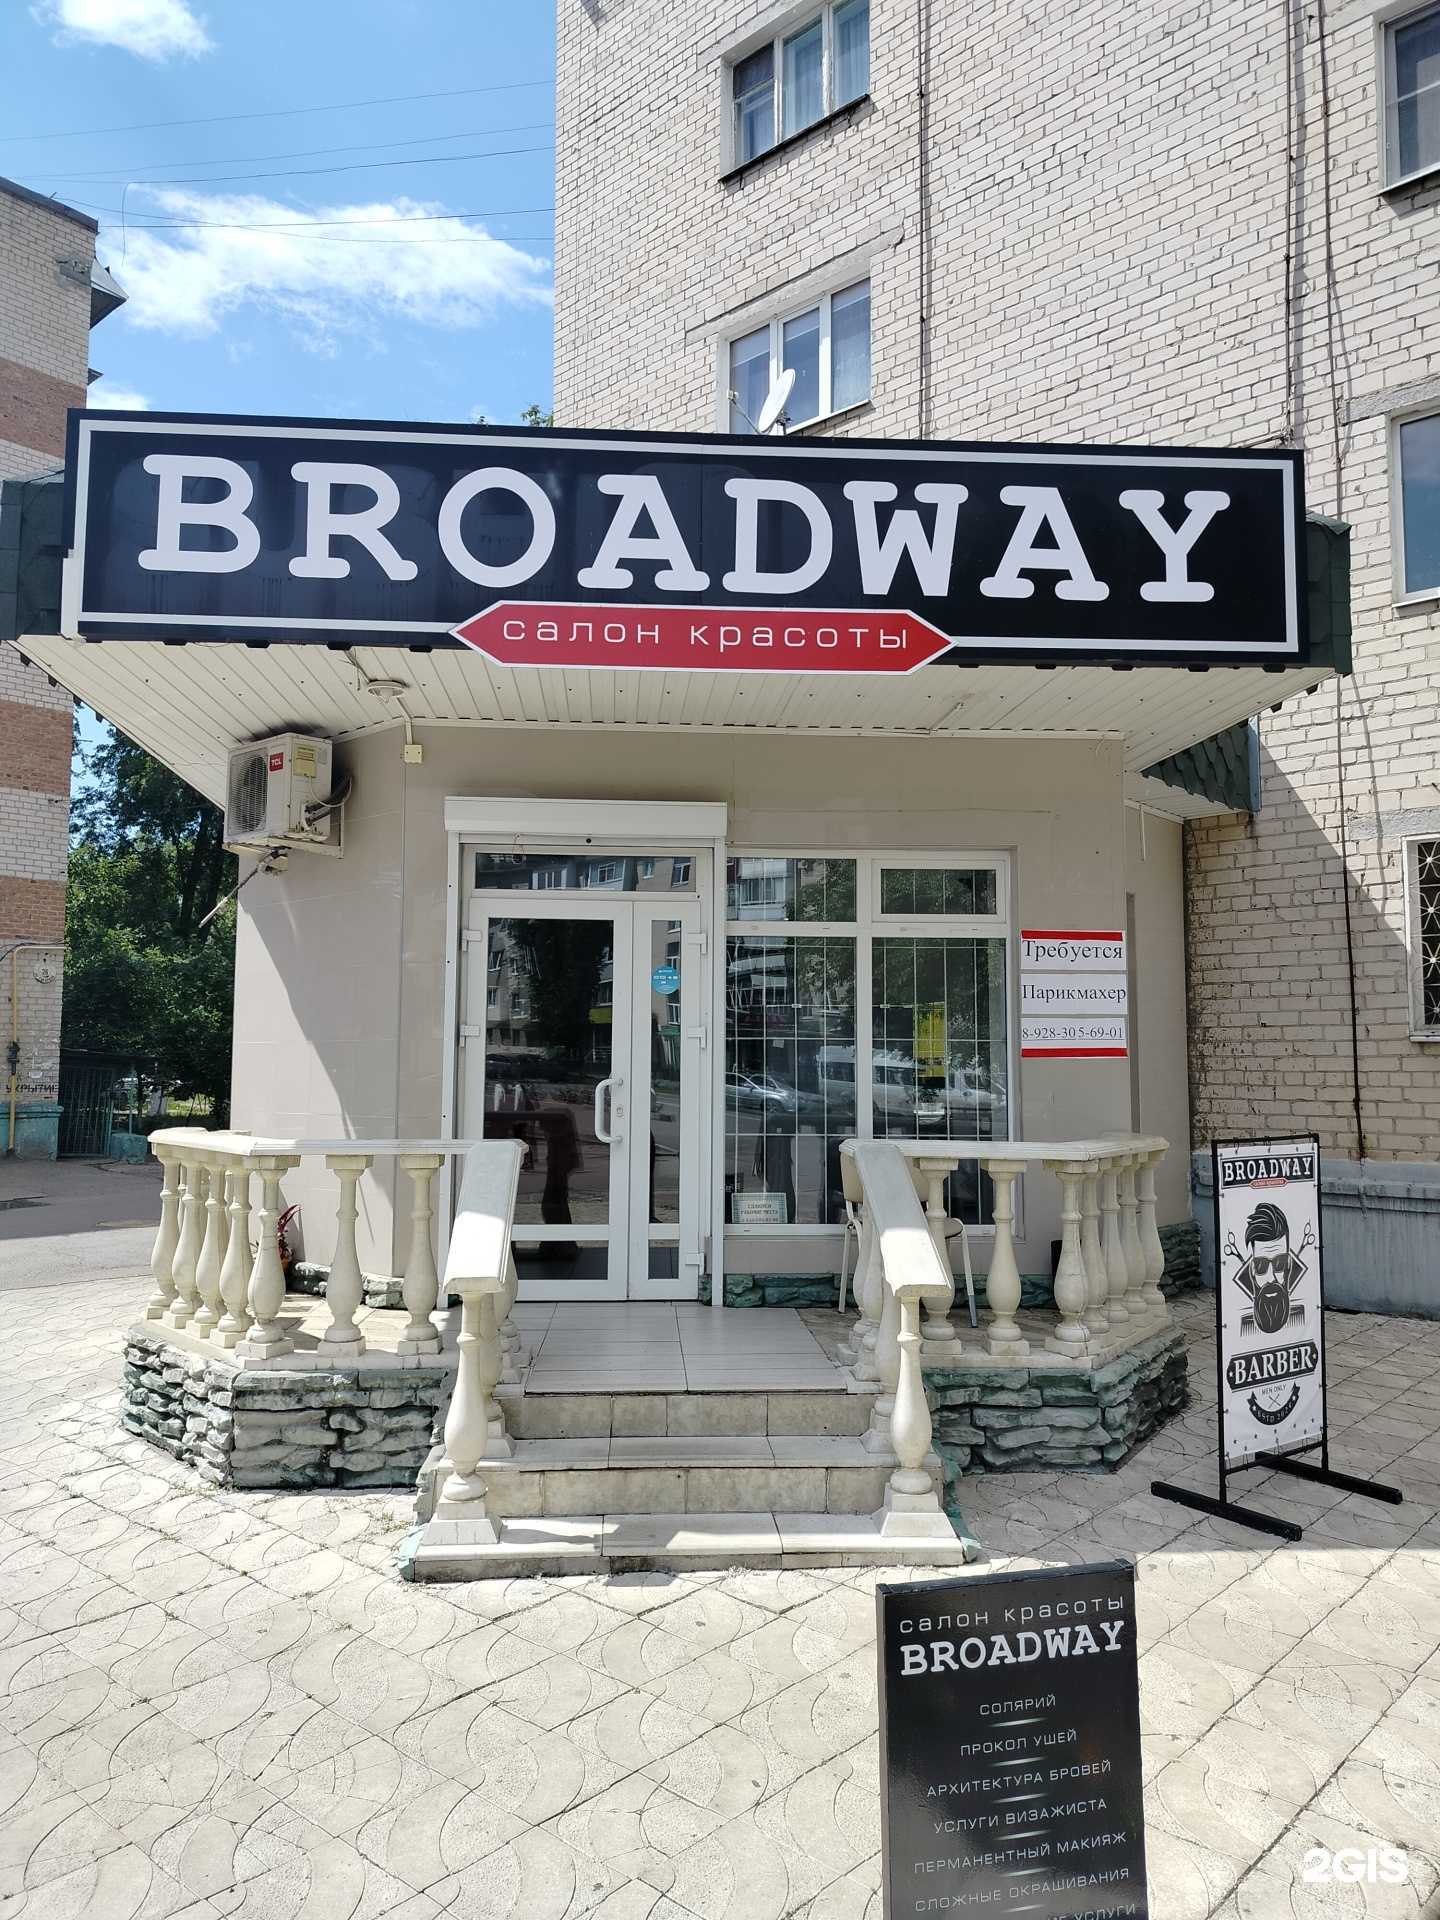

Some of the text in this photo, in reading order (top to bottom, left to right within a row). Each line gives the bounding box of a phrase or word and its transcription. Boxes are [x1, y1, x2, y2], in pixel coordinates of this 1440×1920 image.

[138, 454, 1230, 602] BROADWAY
[503, 620, 907, 652] салон красоты
[1022, 940, 1123, 962] Требуется
[1022, 984, 1127, 1003] Парикмахер
[1022, 1027, 1123, 1039] 8-928-305-69-01
[1224, 1157, 1312, 1181] BROADWAY
[1233, 1346, 1314, 1385] BARBER
[900, 1596, 1124, 1634] салон красоты
[900, 1620, 1125, 1676] BROADWAY
[979, 1694, 1056, 1716] СОЛЯРИЙ
[960, 1728, 1077, 1757] ПРОКОЛ УШЕЙ
[927, 1760, 1111, 1798] АРХИТЕКТУРА БРОВЕЙ
[934, 1798, 1107, 1834] УСЛУГИ ВИЗАЖИСТА
[914, 1832, 1127, 1874] ПЕРМАНЕНТНЫЙ МАКИЯЖ
[915, 1868, 1129, 1912] СЛОЖНЫЕ ОКРАШИВАНИЯ
